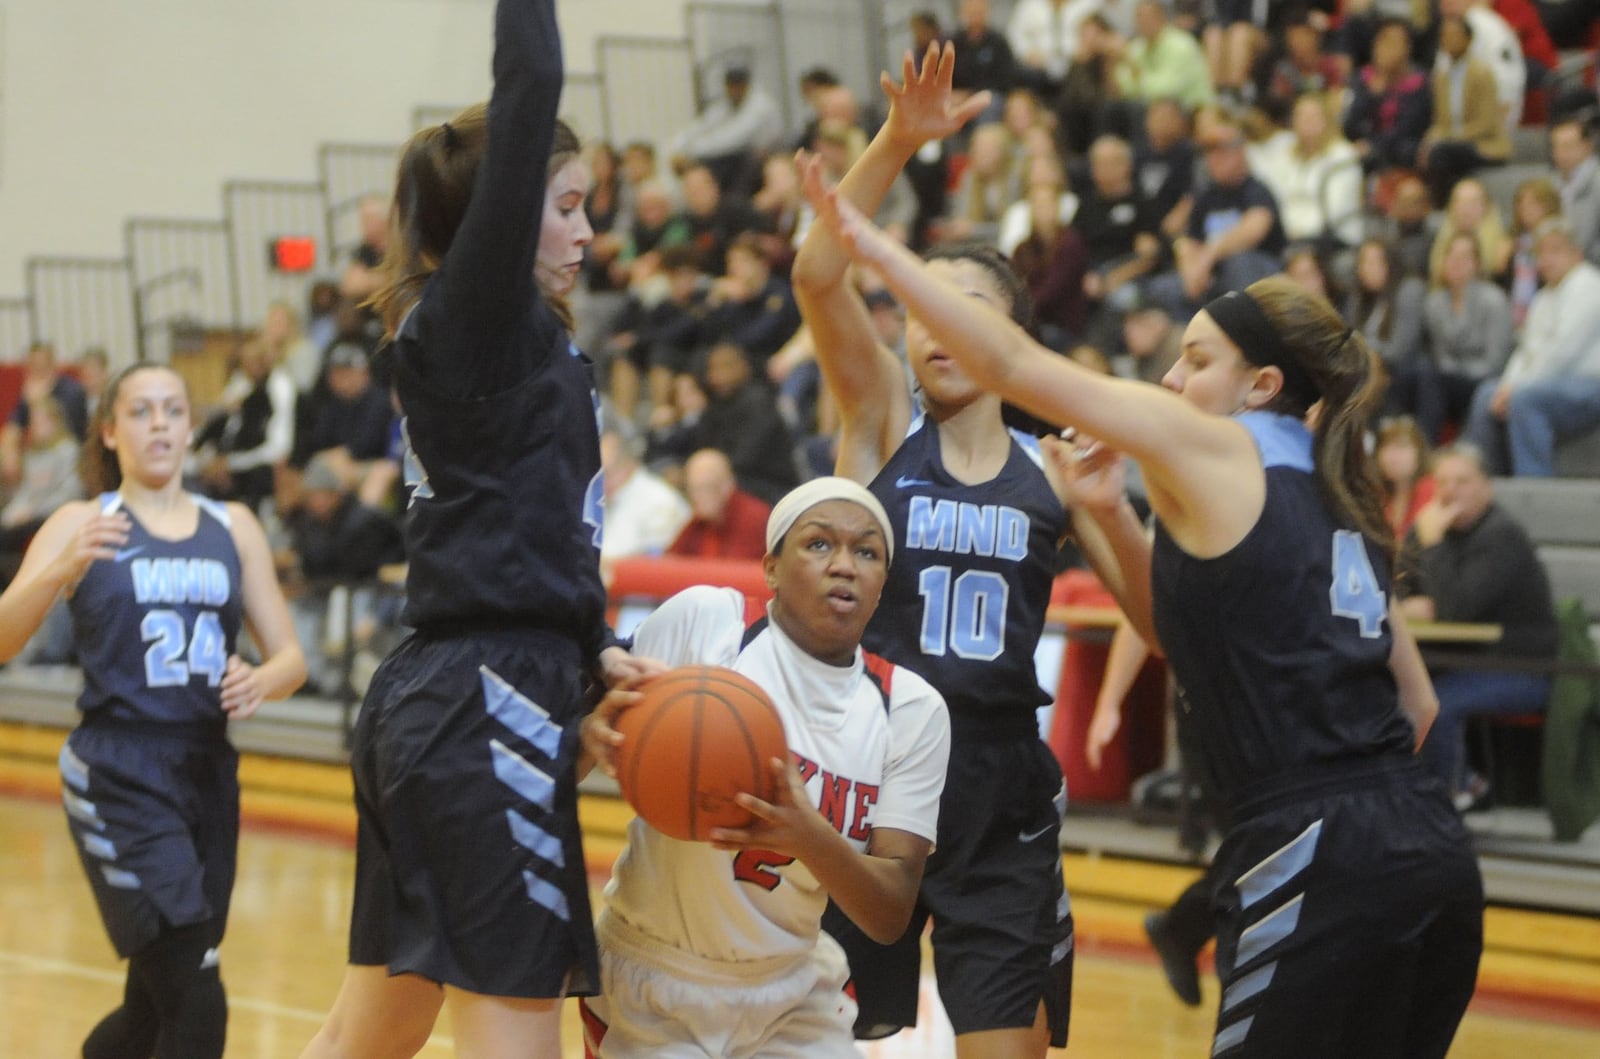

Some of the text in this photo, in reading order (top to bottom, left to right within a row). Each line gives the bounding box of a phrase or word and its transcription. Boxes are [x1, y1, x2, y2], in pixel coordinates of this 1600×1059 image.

[906, 496, 1030, 562] MND
[130, 557, 230, 607] MND
[918, 565, 1009, 662] 10
[1329, 529, 1387, 639] 4
[140, 609, 228, 688] 24
